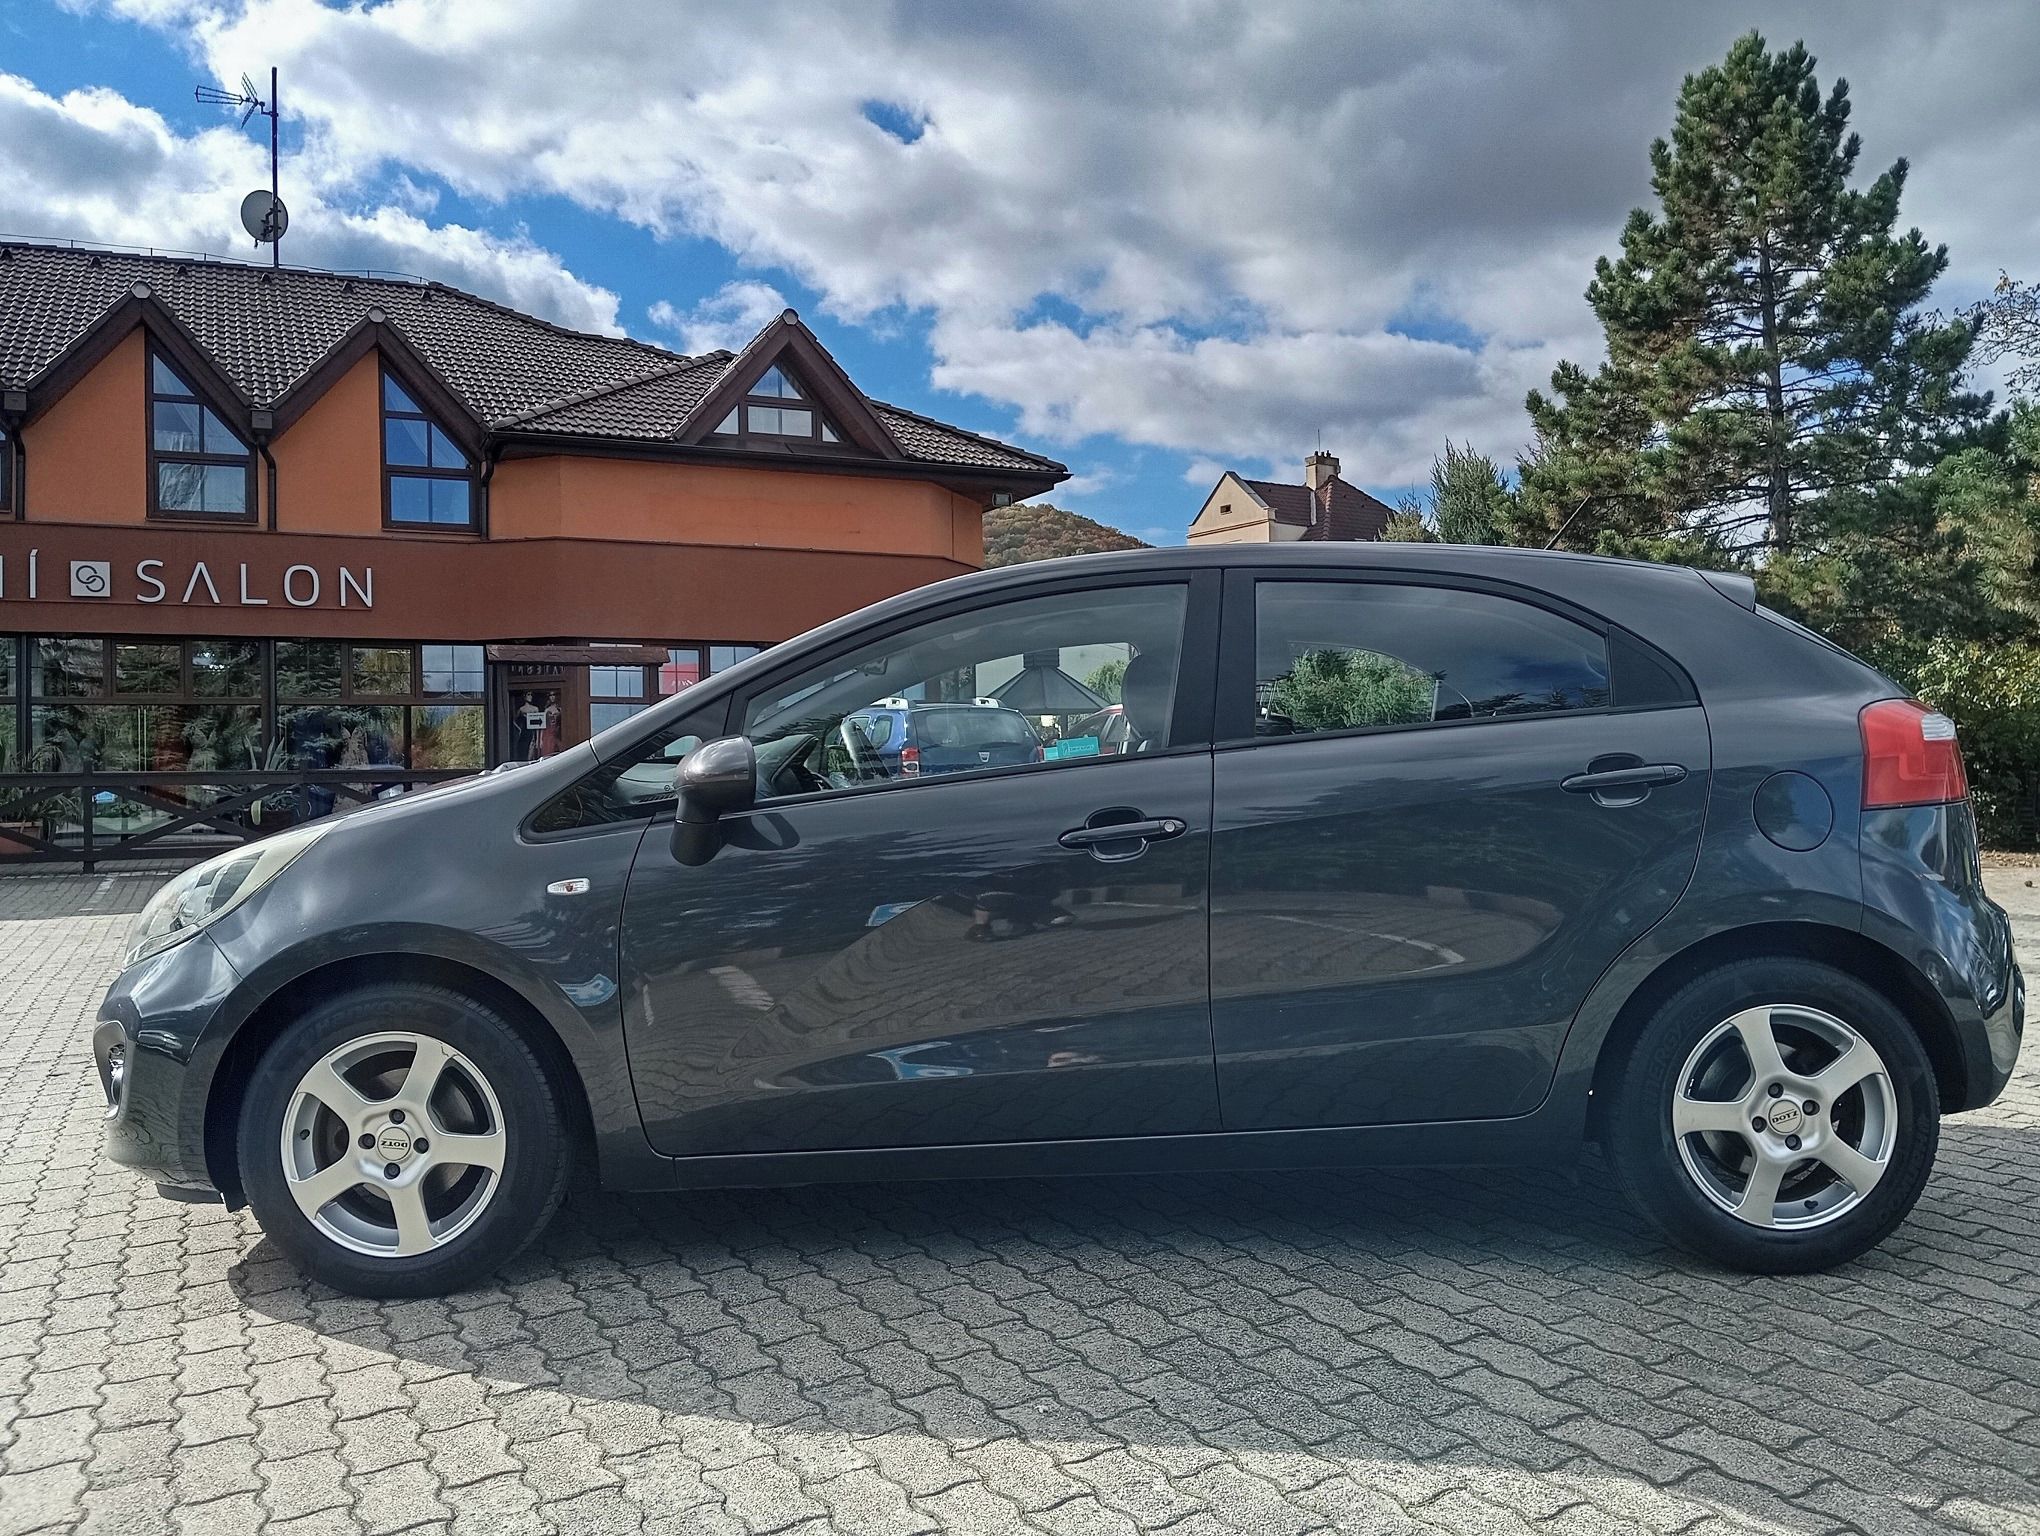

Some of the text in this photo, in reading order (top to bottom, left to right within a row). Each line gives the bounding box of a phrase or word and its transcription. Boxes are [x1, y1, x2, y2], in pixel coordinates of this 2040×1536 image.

[0, 549, 374, 608] Í SALON
[1771, 1109, 1800, 1124] DOTZ
[380, 1140, 408, 1148] DOTZ
